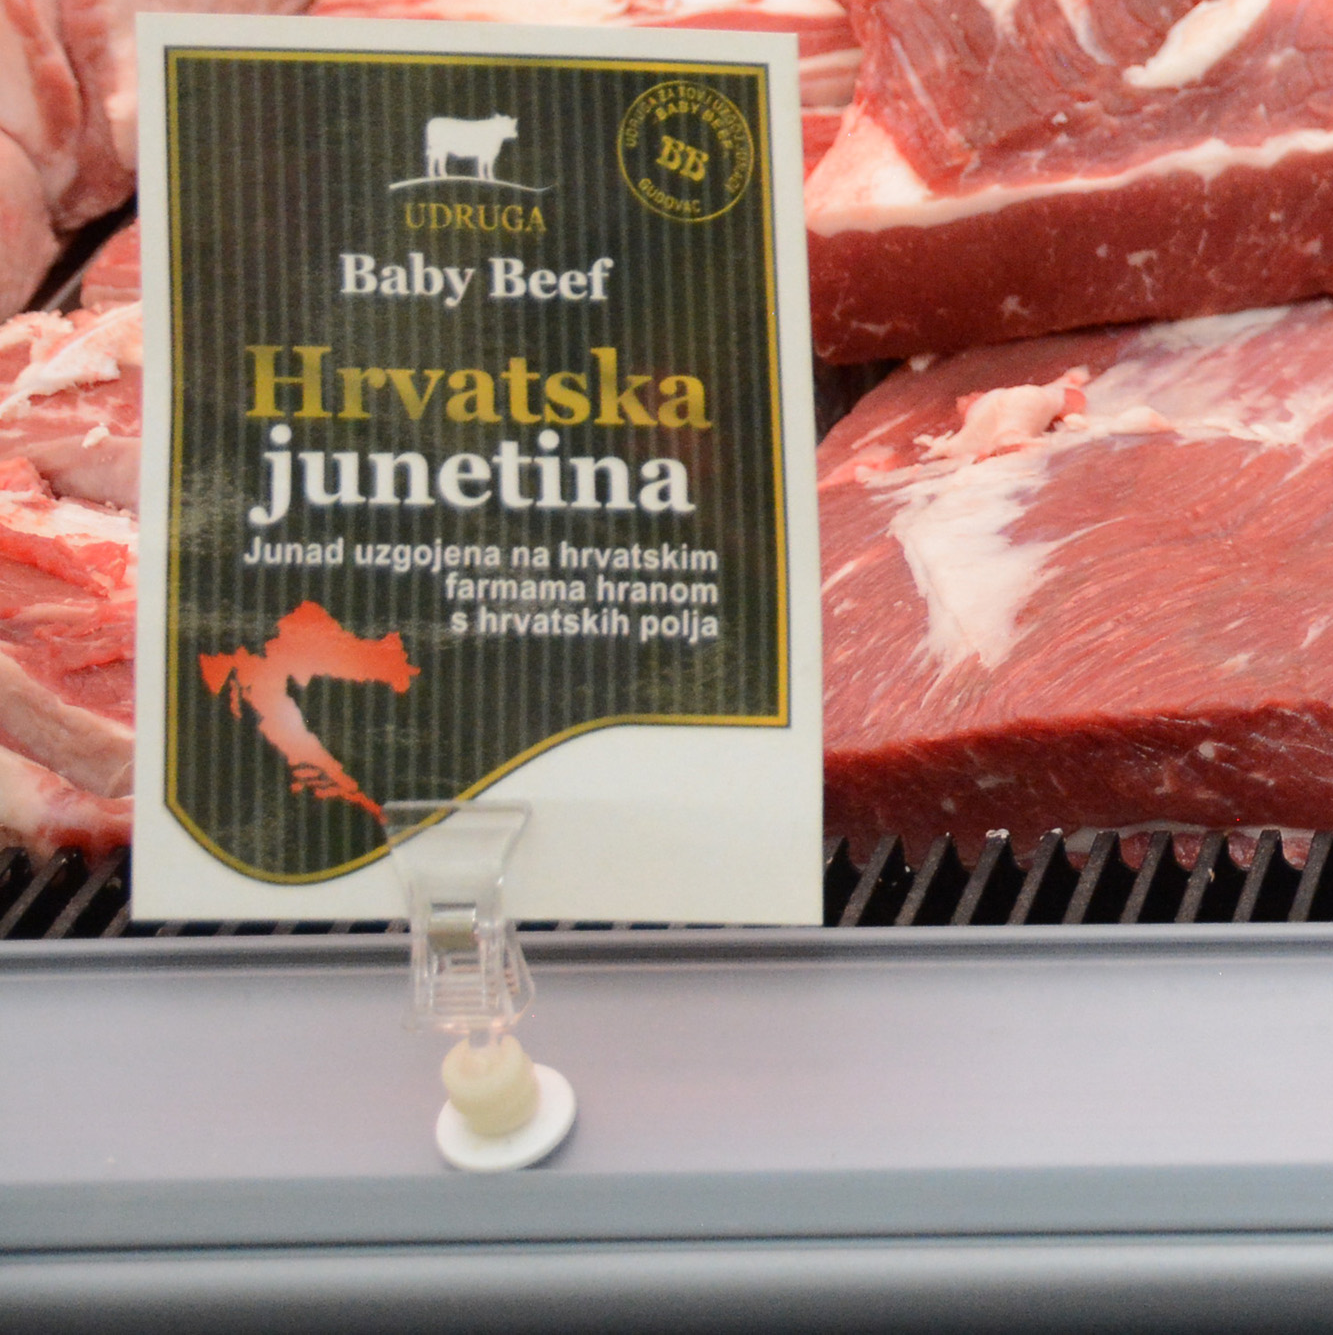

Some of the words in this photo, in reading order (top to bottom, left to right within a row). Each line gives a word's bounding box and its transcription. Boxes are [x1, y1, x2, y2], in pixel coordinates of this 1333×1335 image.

[655, 100, 700, 121] BABY
[404, 202, 547, 232] UDRUGA
[339, 252, 477, 307] Baby
[488, 257, 615, 300] Beef
[245, 345, 713, 430] Hrvatska
[248, 423, 697, 526] junetina
[243, 536, 344, 565] Junad
[354, 538, 500, 573] uzgojena
[511, 545, 551, 567] na
[560, 541, 719, 571] hrvatskim
[445, 571, 587, 600] farmama
[596, 574, 719, 604] hranom
[450, 610, 469, 634] s
[478, 605, 631, 636] hrvatskih
[640, 608, 719, 644] polja
